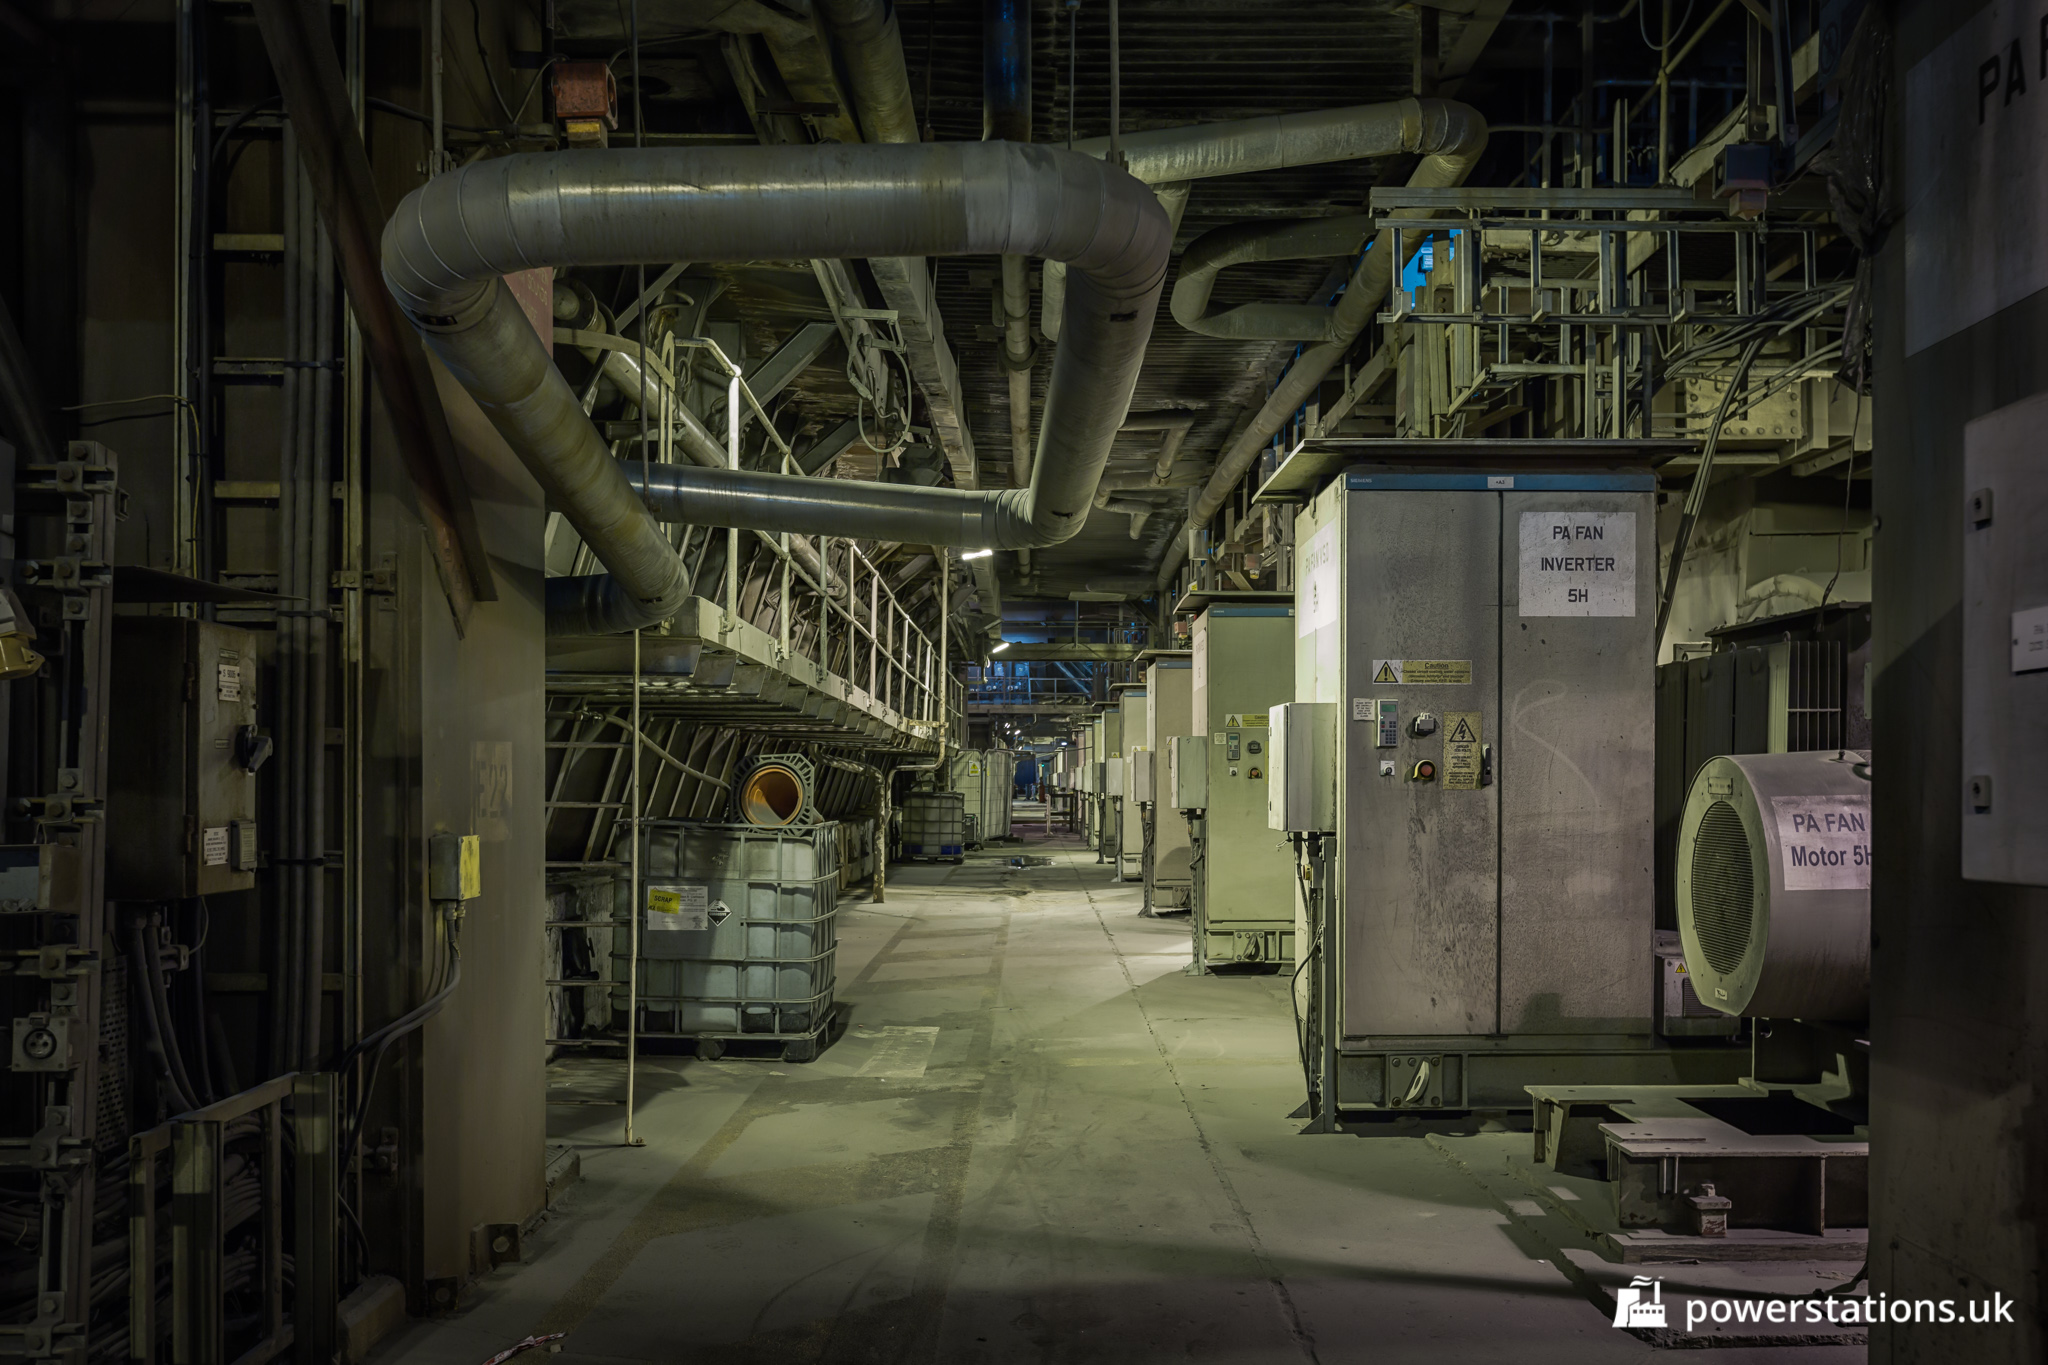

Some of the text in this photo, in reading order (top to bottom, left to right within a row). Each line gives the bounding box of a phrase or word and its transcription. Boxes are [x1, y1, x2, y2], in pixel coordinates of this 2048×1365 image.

[1979, 37, 2026, 126] PA
[1553, 526, 1603, 540] PA FAN
[1541, 558, 1615, 572] INVERTER
[1568, 589, 1588, 602] 5H
[1792, 813, 1866, 832] PA FAN
[1791, 846, 1846, 866] Motor
[654, 895, 672, 903] SCRAP
